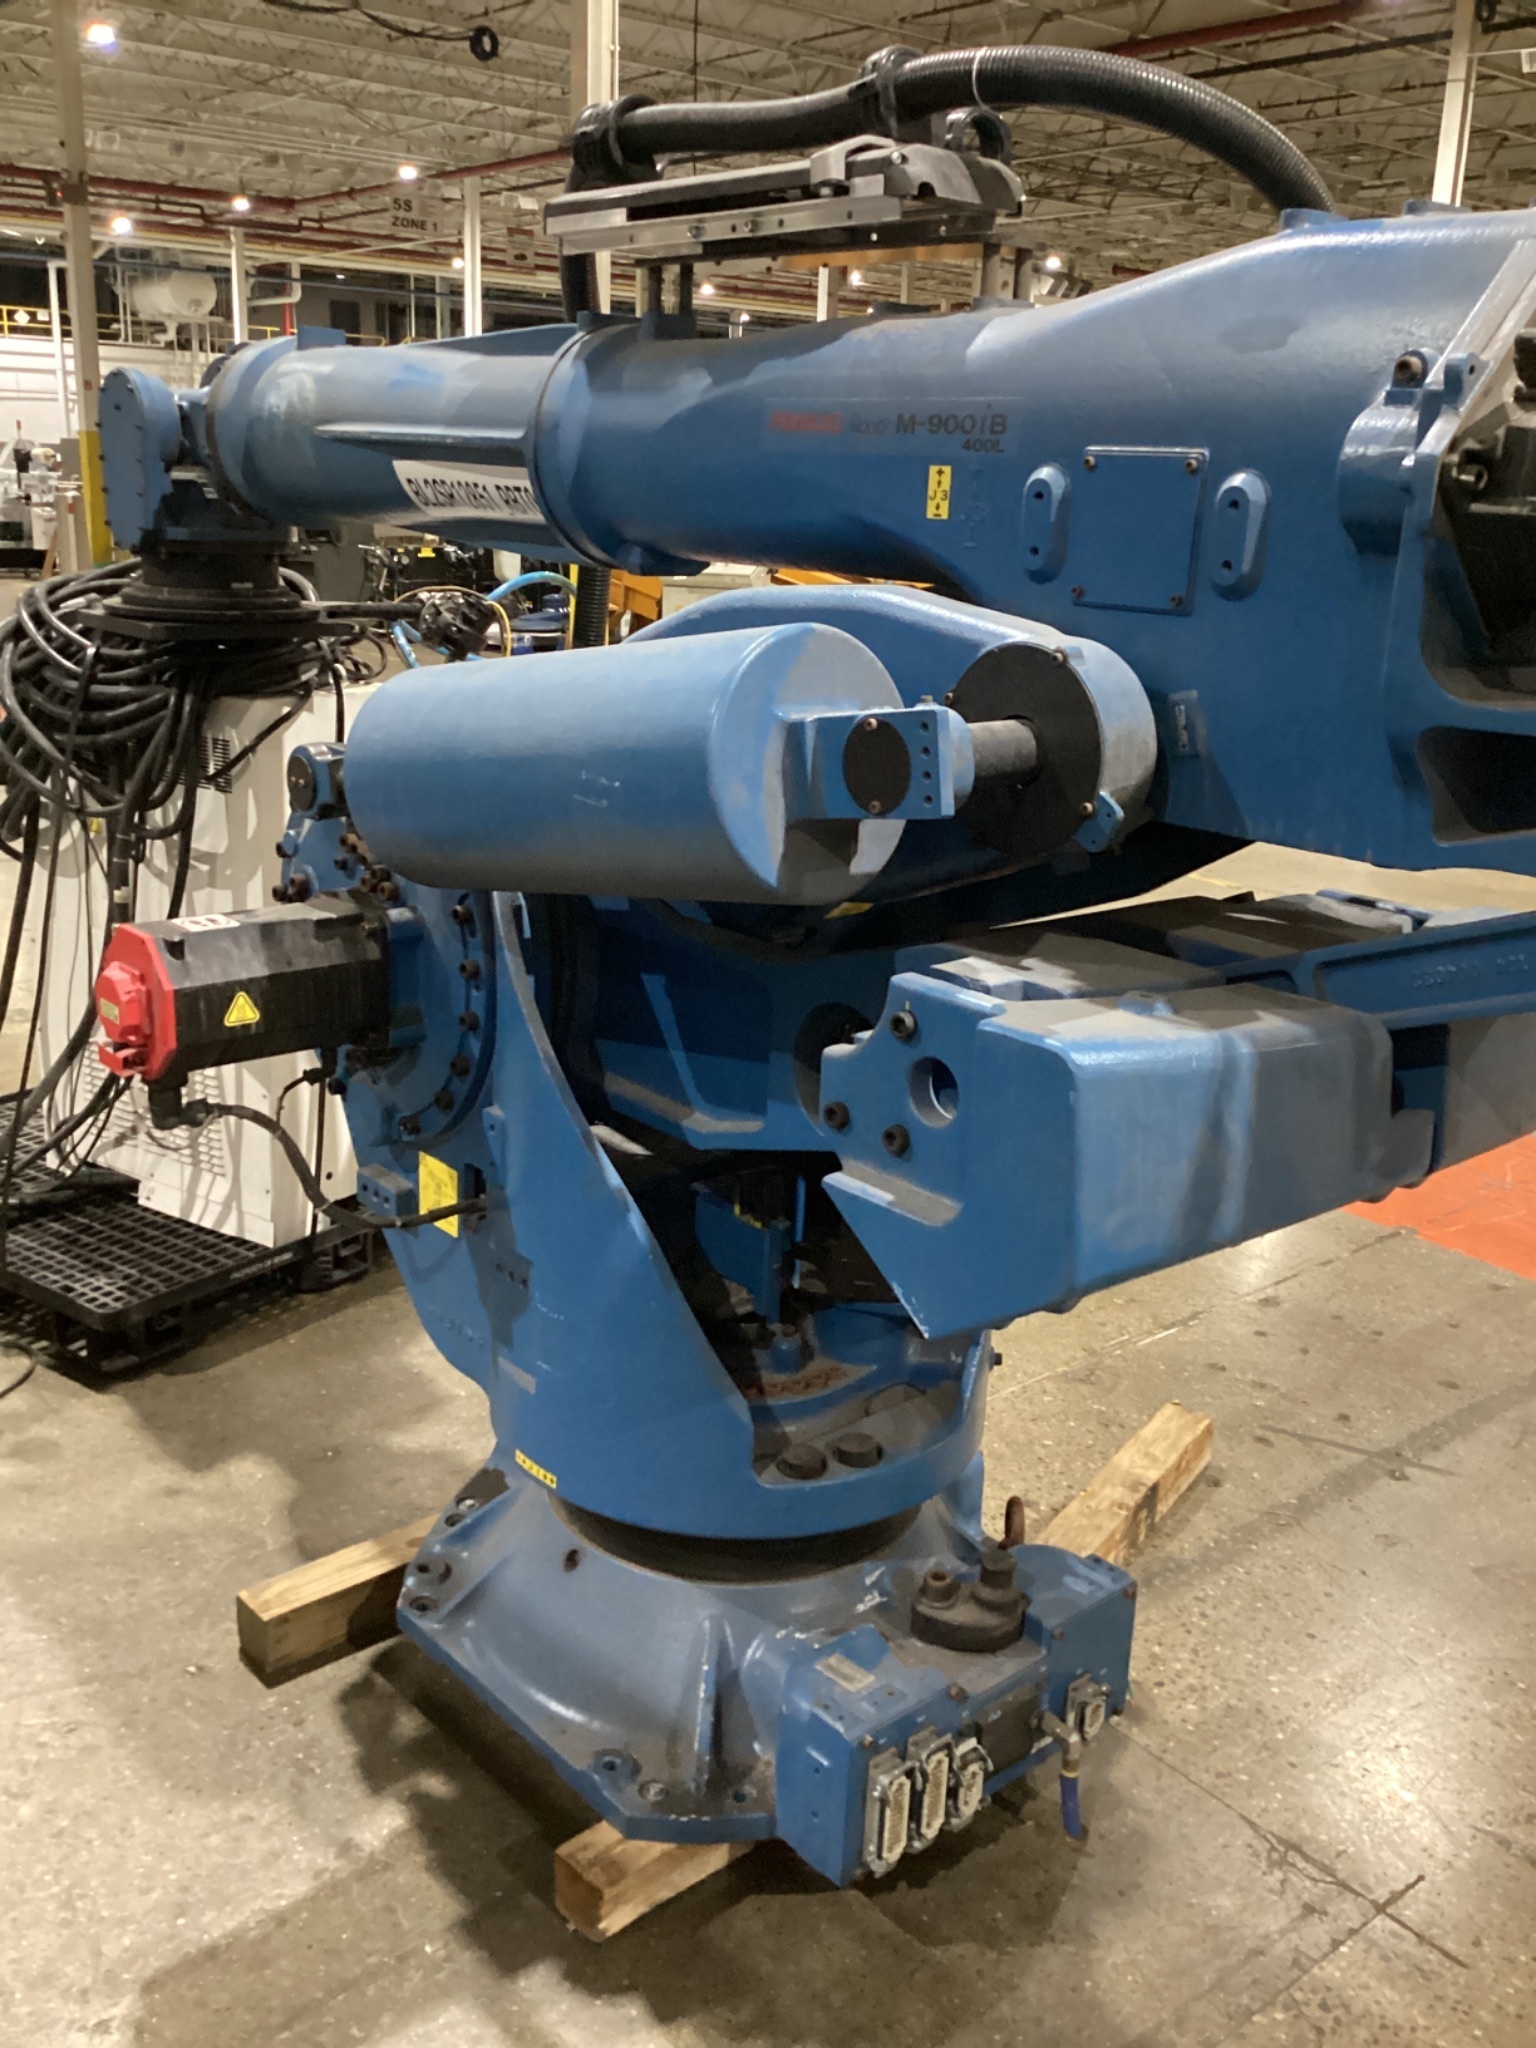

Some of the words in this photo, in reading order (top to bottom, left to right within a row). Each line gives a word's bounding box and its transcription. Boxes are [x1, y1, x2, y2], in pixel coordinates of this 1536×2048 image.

[392, 198, 413, 213] 5S
[391, 216, 428, 231] ZONE
[432, 222, 438, 232] 1
[962, 439, 1005, 454] 400L
